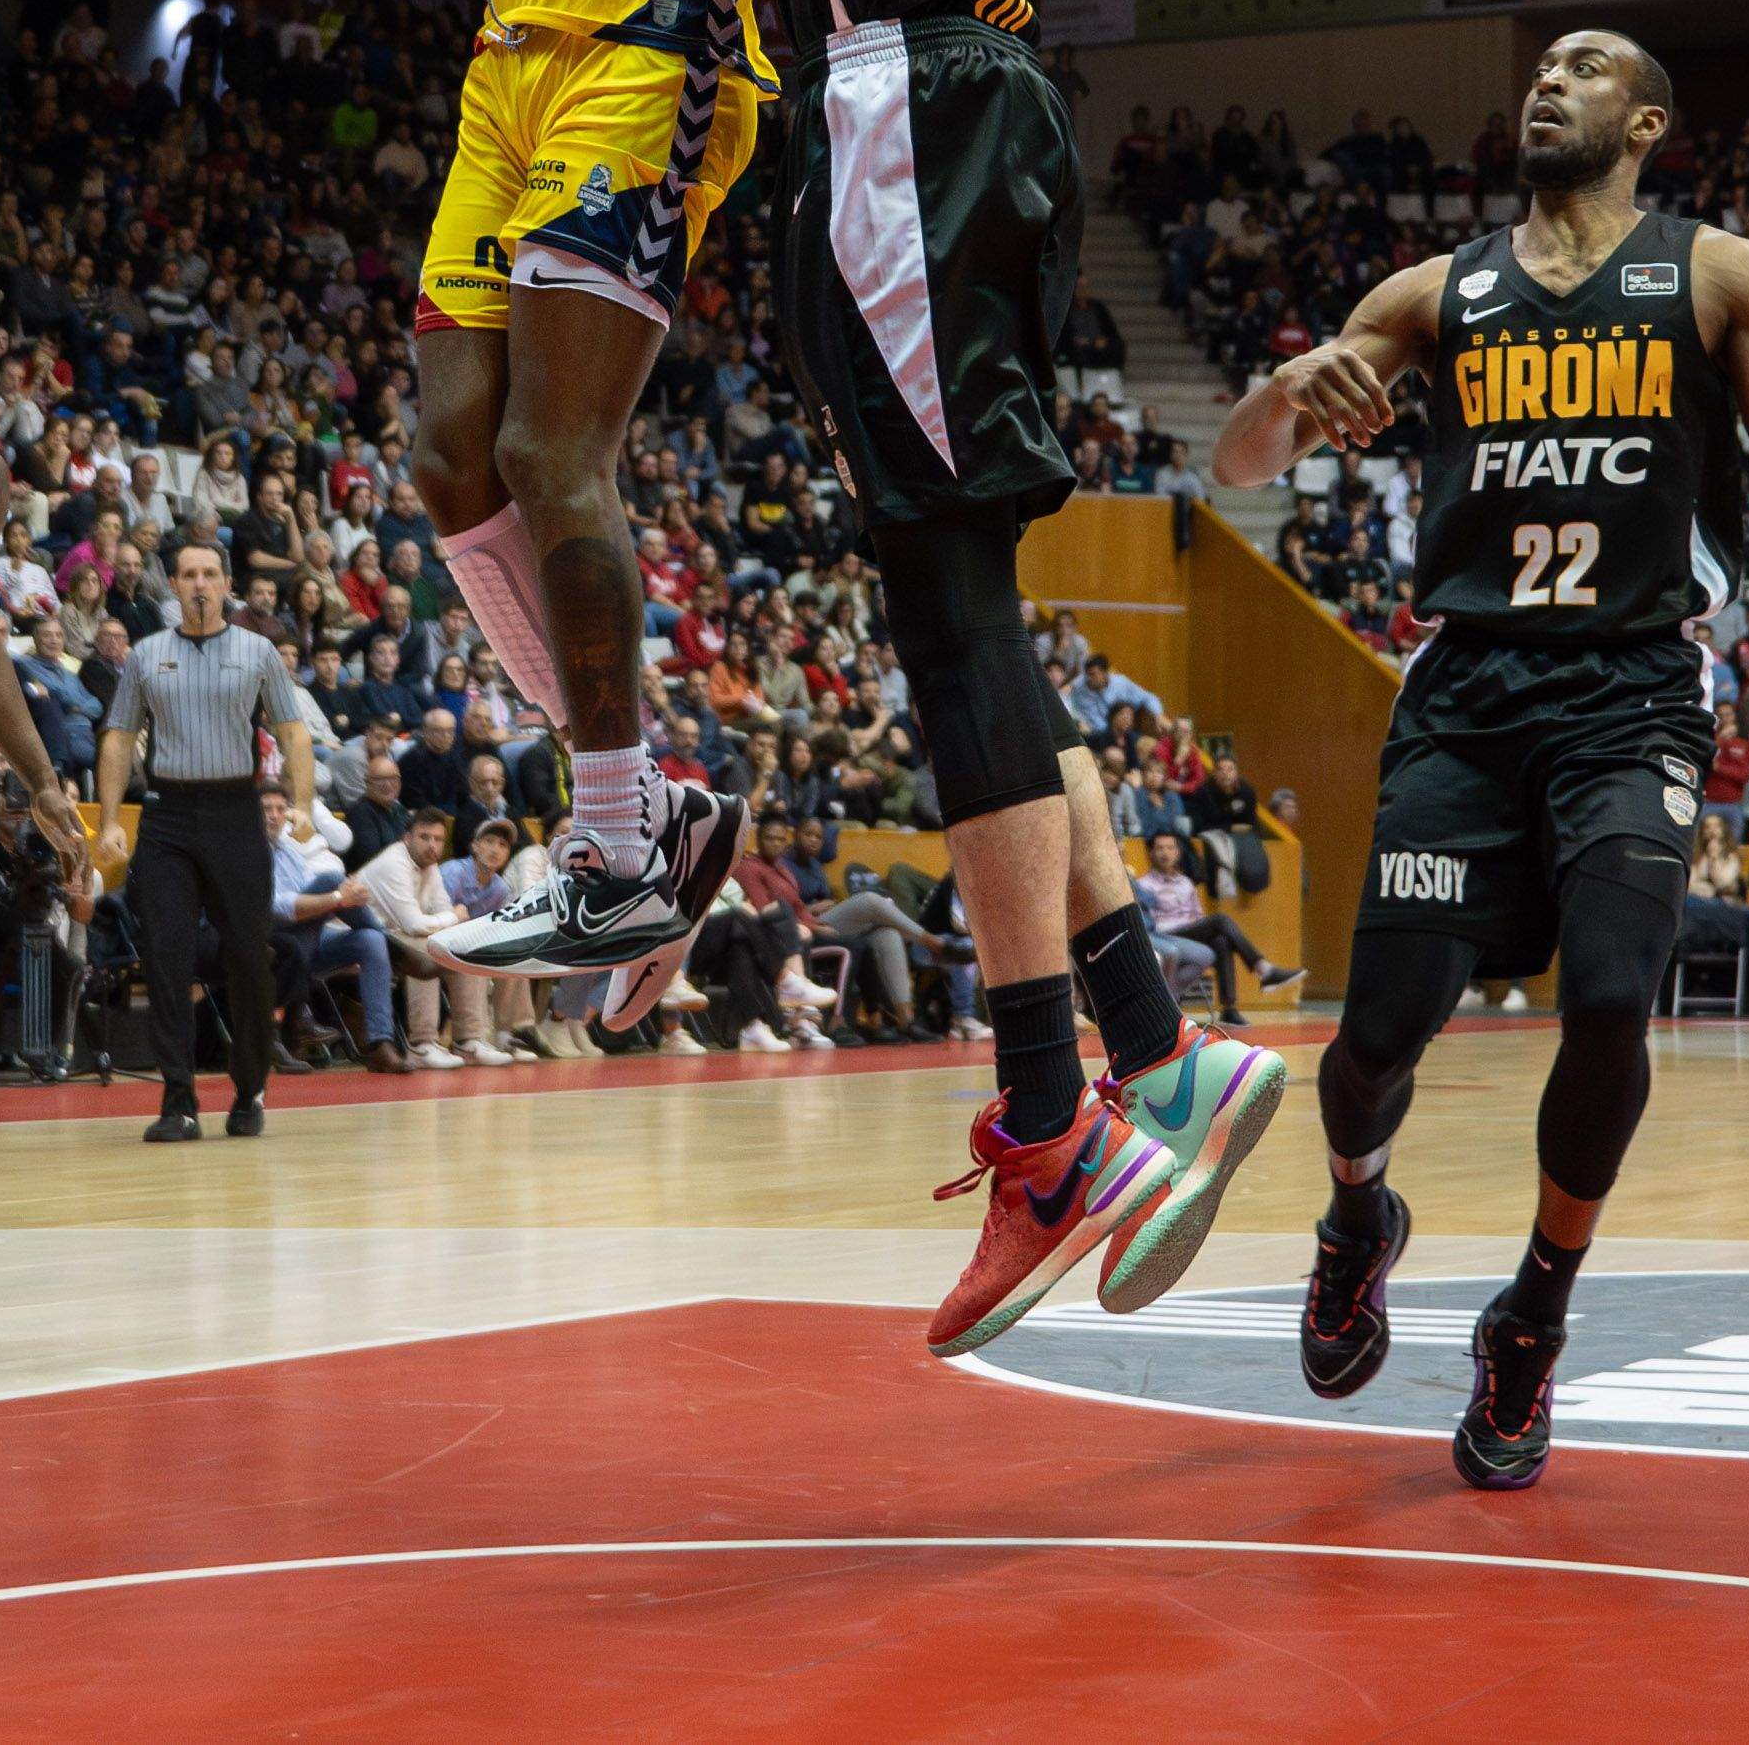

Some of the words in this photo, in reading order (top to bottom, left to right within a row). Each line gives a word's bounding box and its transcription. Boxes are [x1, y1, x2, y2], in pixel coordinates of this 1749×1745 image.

[435, 276, 503, 292] Andorra
[1627, 281, 1674, 292] endesa
[1454, 339, 1674, 429] GIRONA
[1470, 436, 1654, 492] FIATC
[1509, 520, 1601, 607] 22
[1379, 851, 1470, 904] YOSOY
